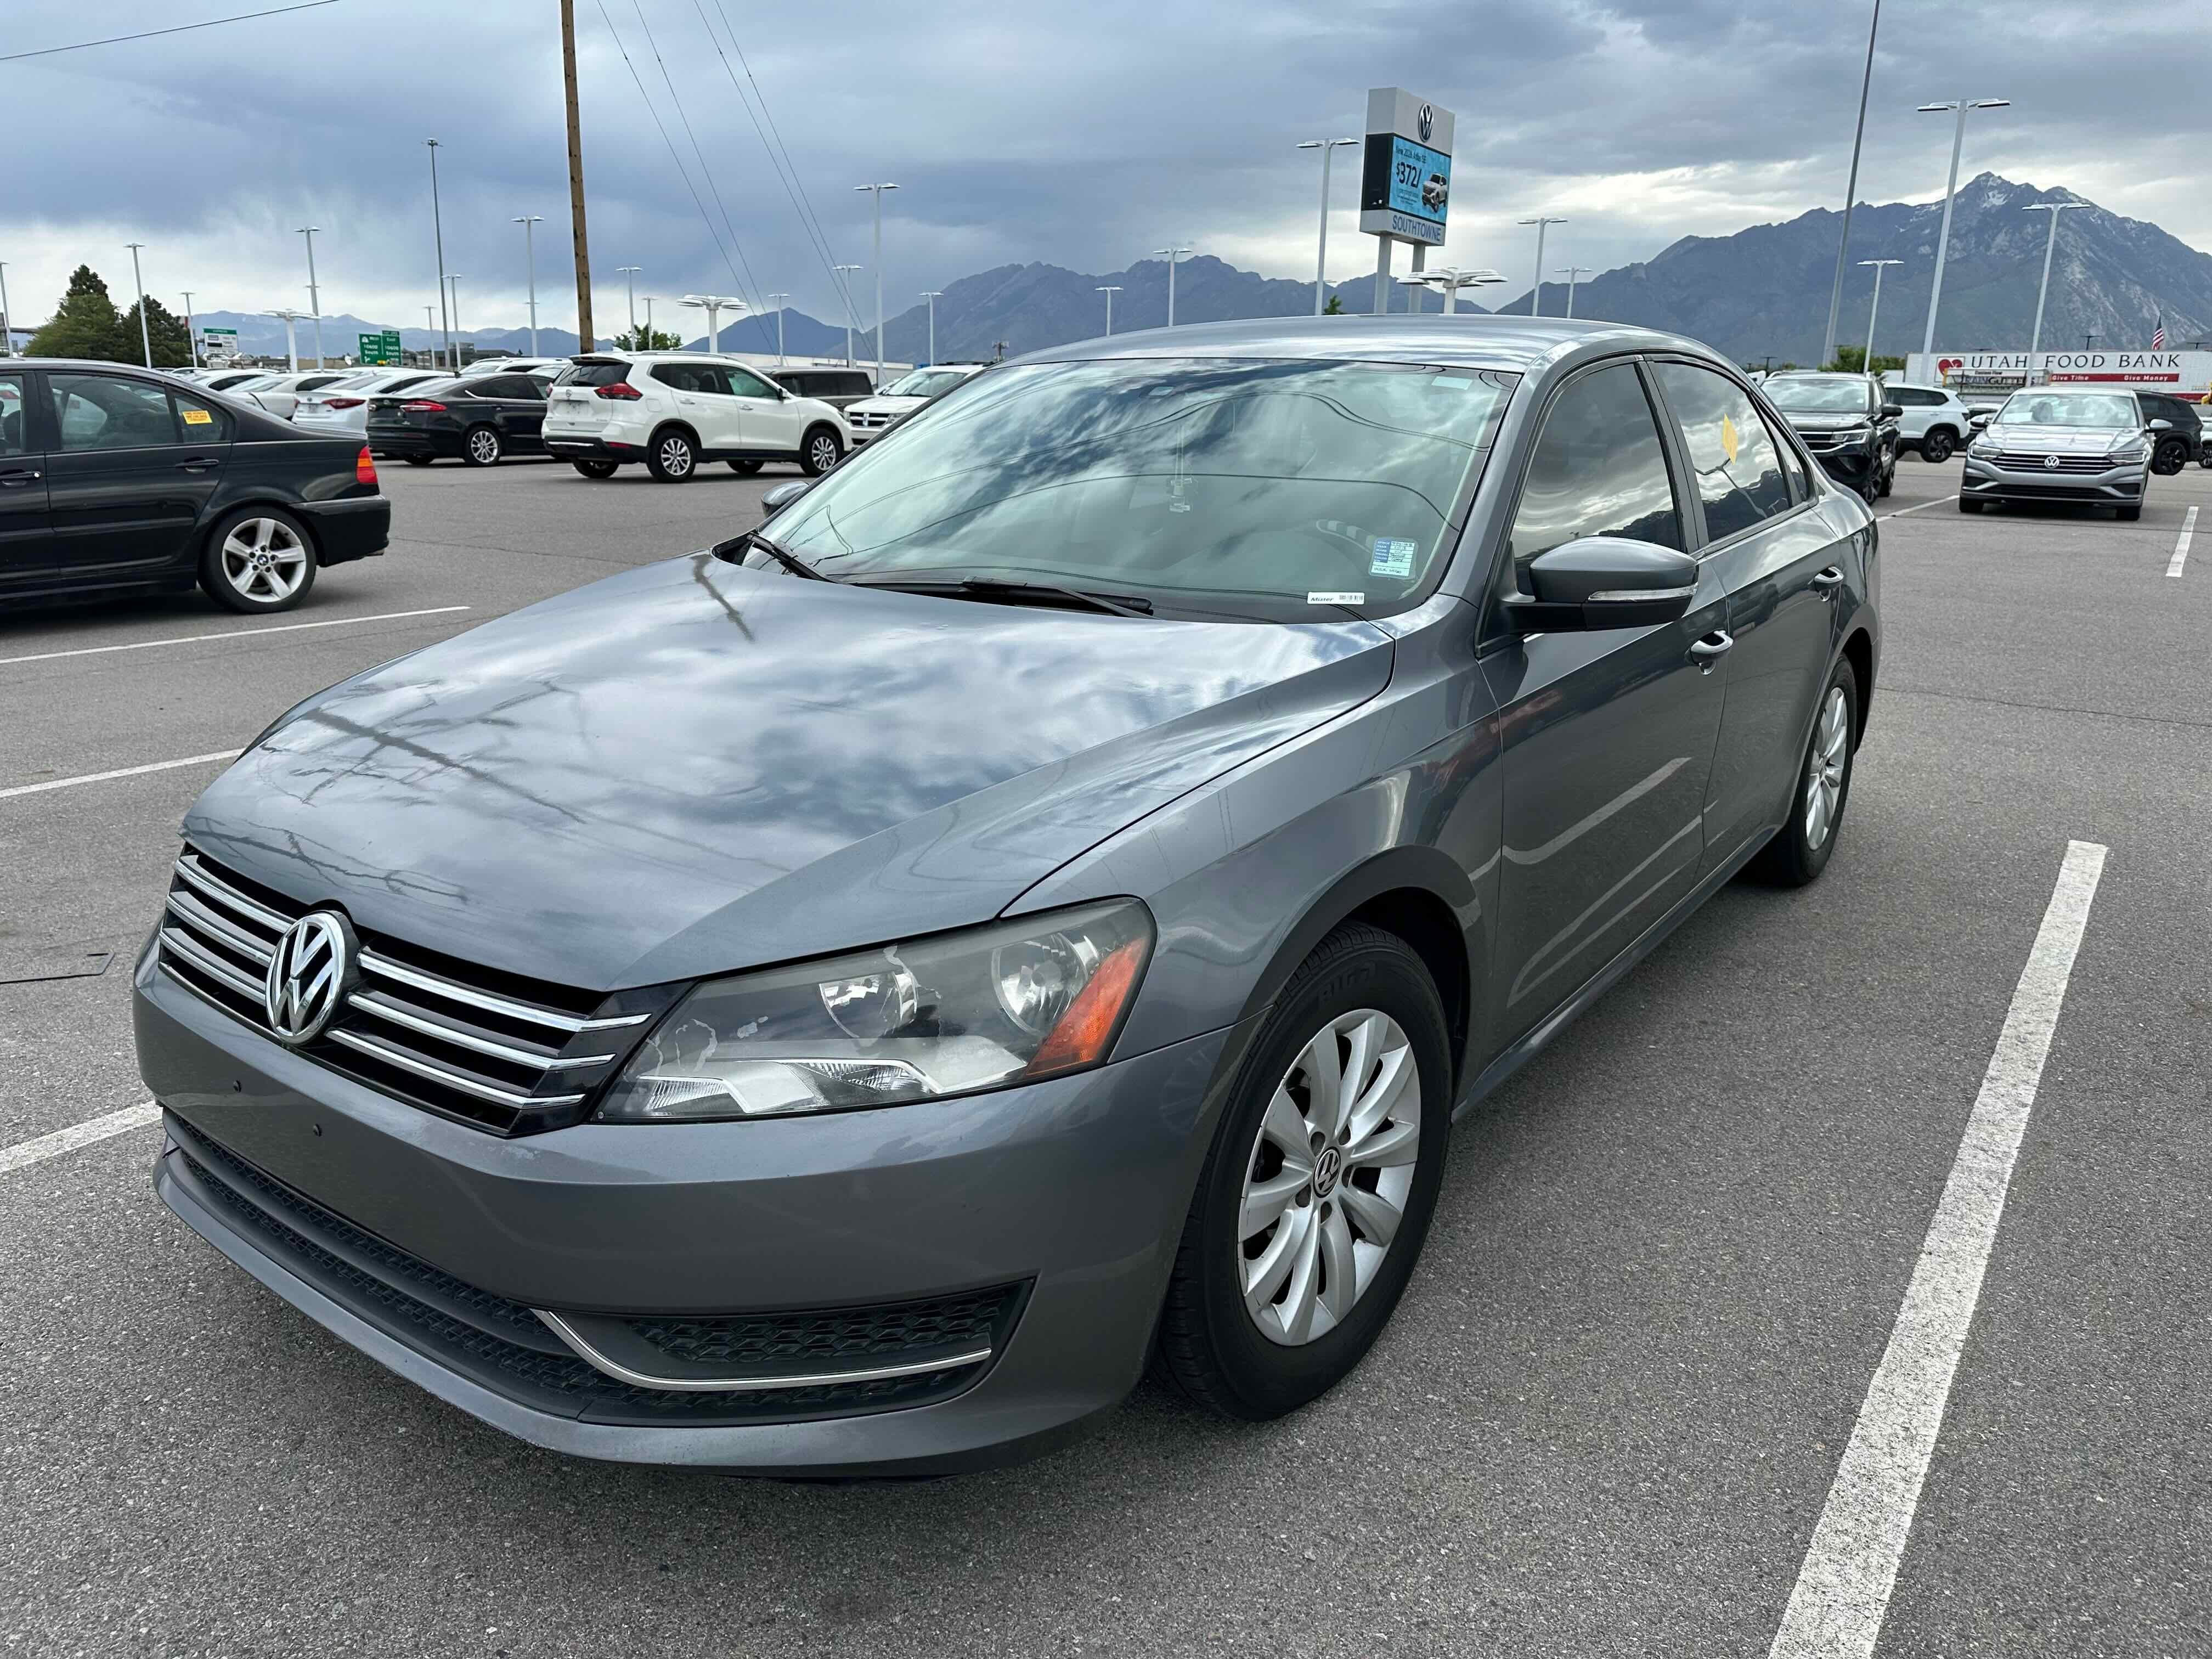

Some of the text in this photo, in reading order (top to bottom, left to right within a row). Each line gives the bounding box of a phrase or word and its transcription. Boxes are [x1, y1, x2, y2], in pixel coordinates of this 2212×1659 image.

[1392, 215, 1441, 241] SOUTHTOWNE
[1971, 354, 2181, 368] UTAH FOOD BANK
